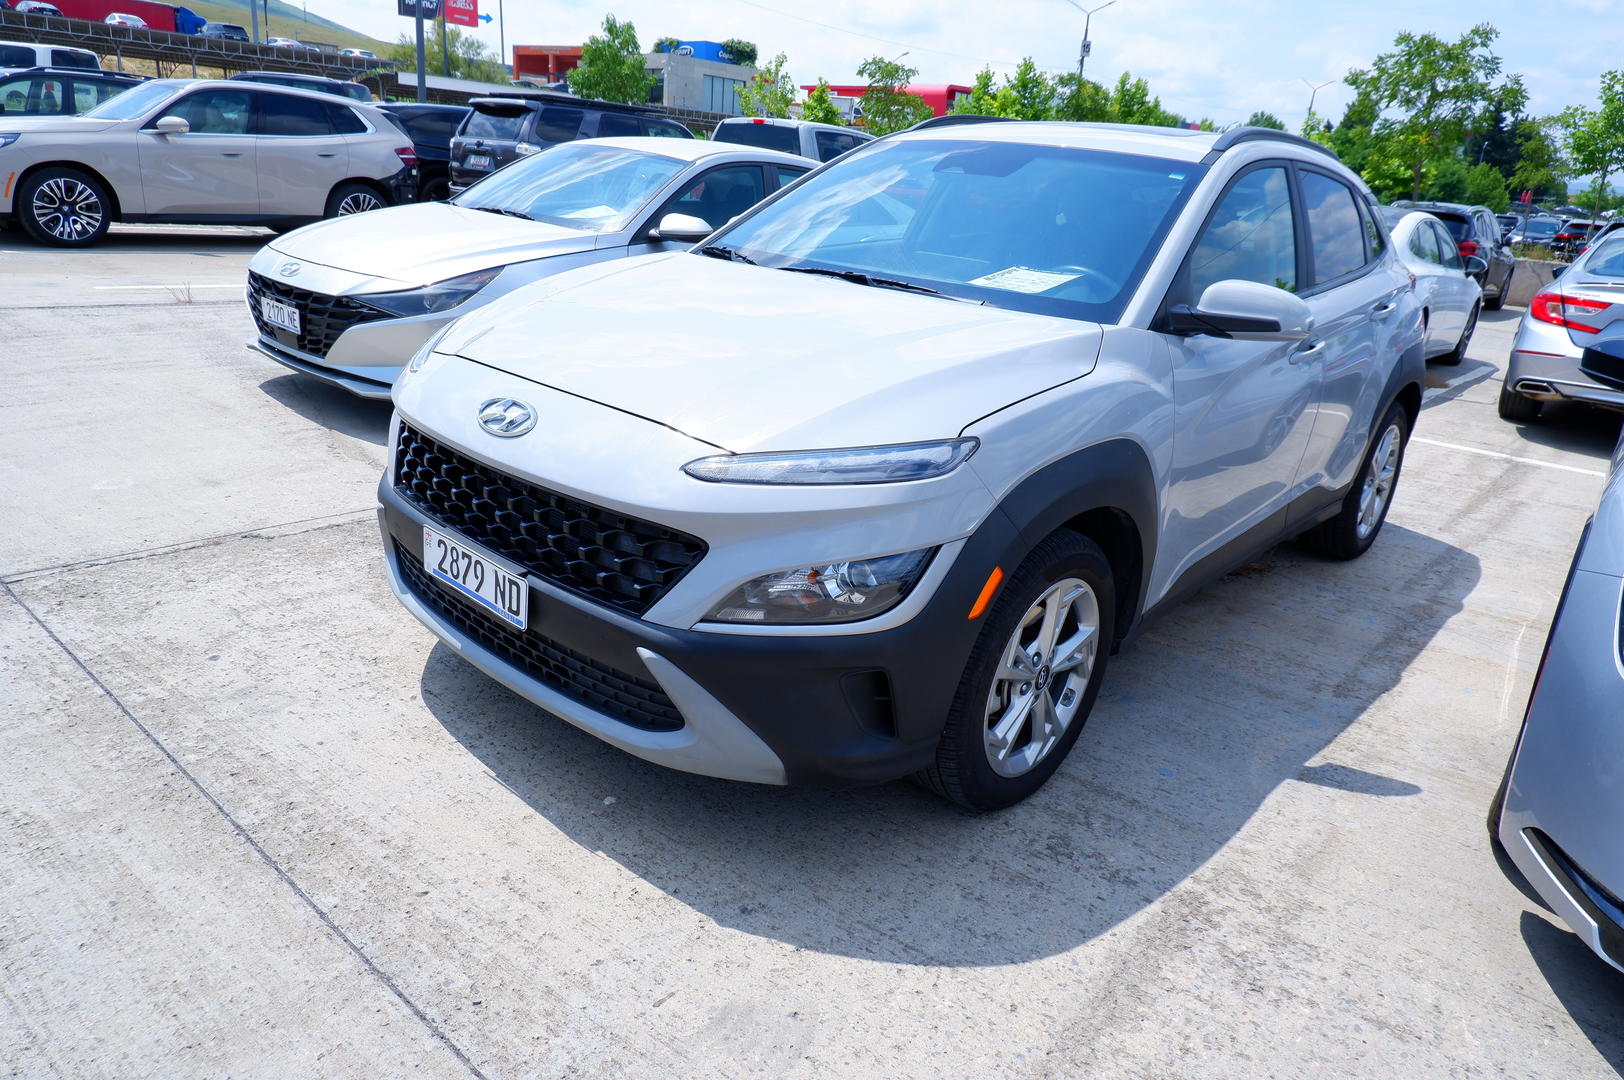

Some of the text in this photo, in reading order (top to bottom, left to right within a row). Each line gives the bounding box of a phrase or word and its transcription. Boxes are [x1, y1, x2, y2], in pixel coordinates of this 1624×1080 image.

[1082, 43, 1091, 53] 15
[266, 301, 298, 329] 2170 NE
[437, 538, 521, 617] 2879 ND
